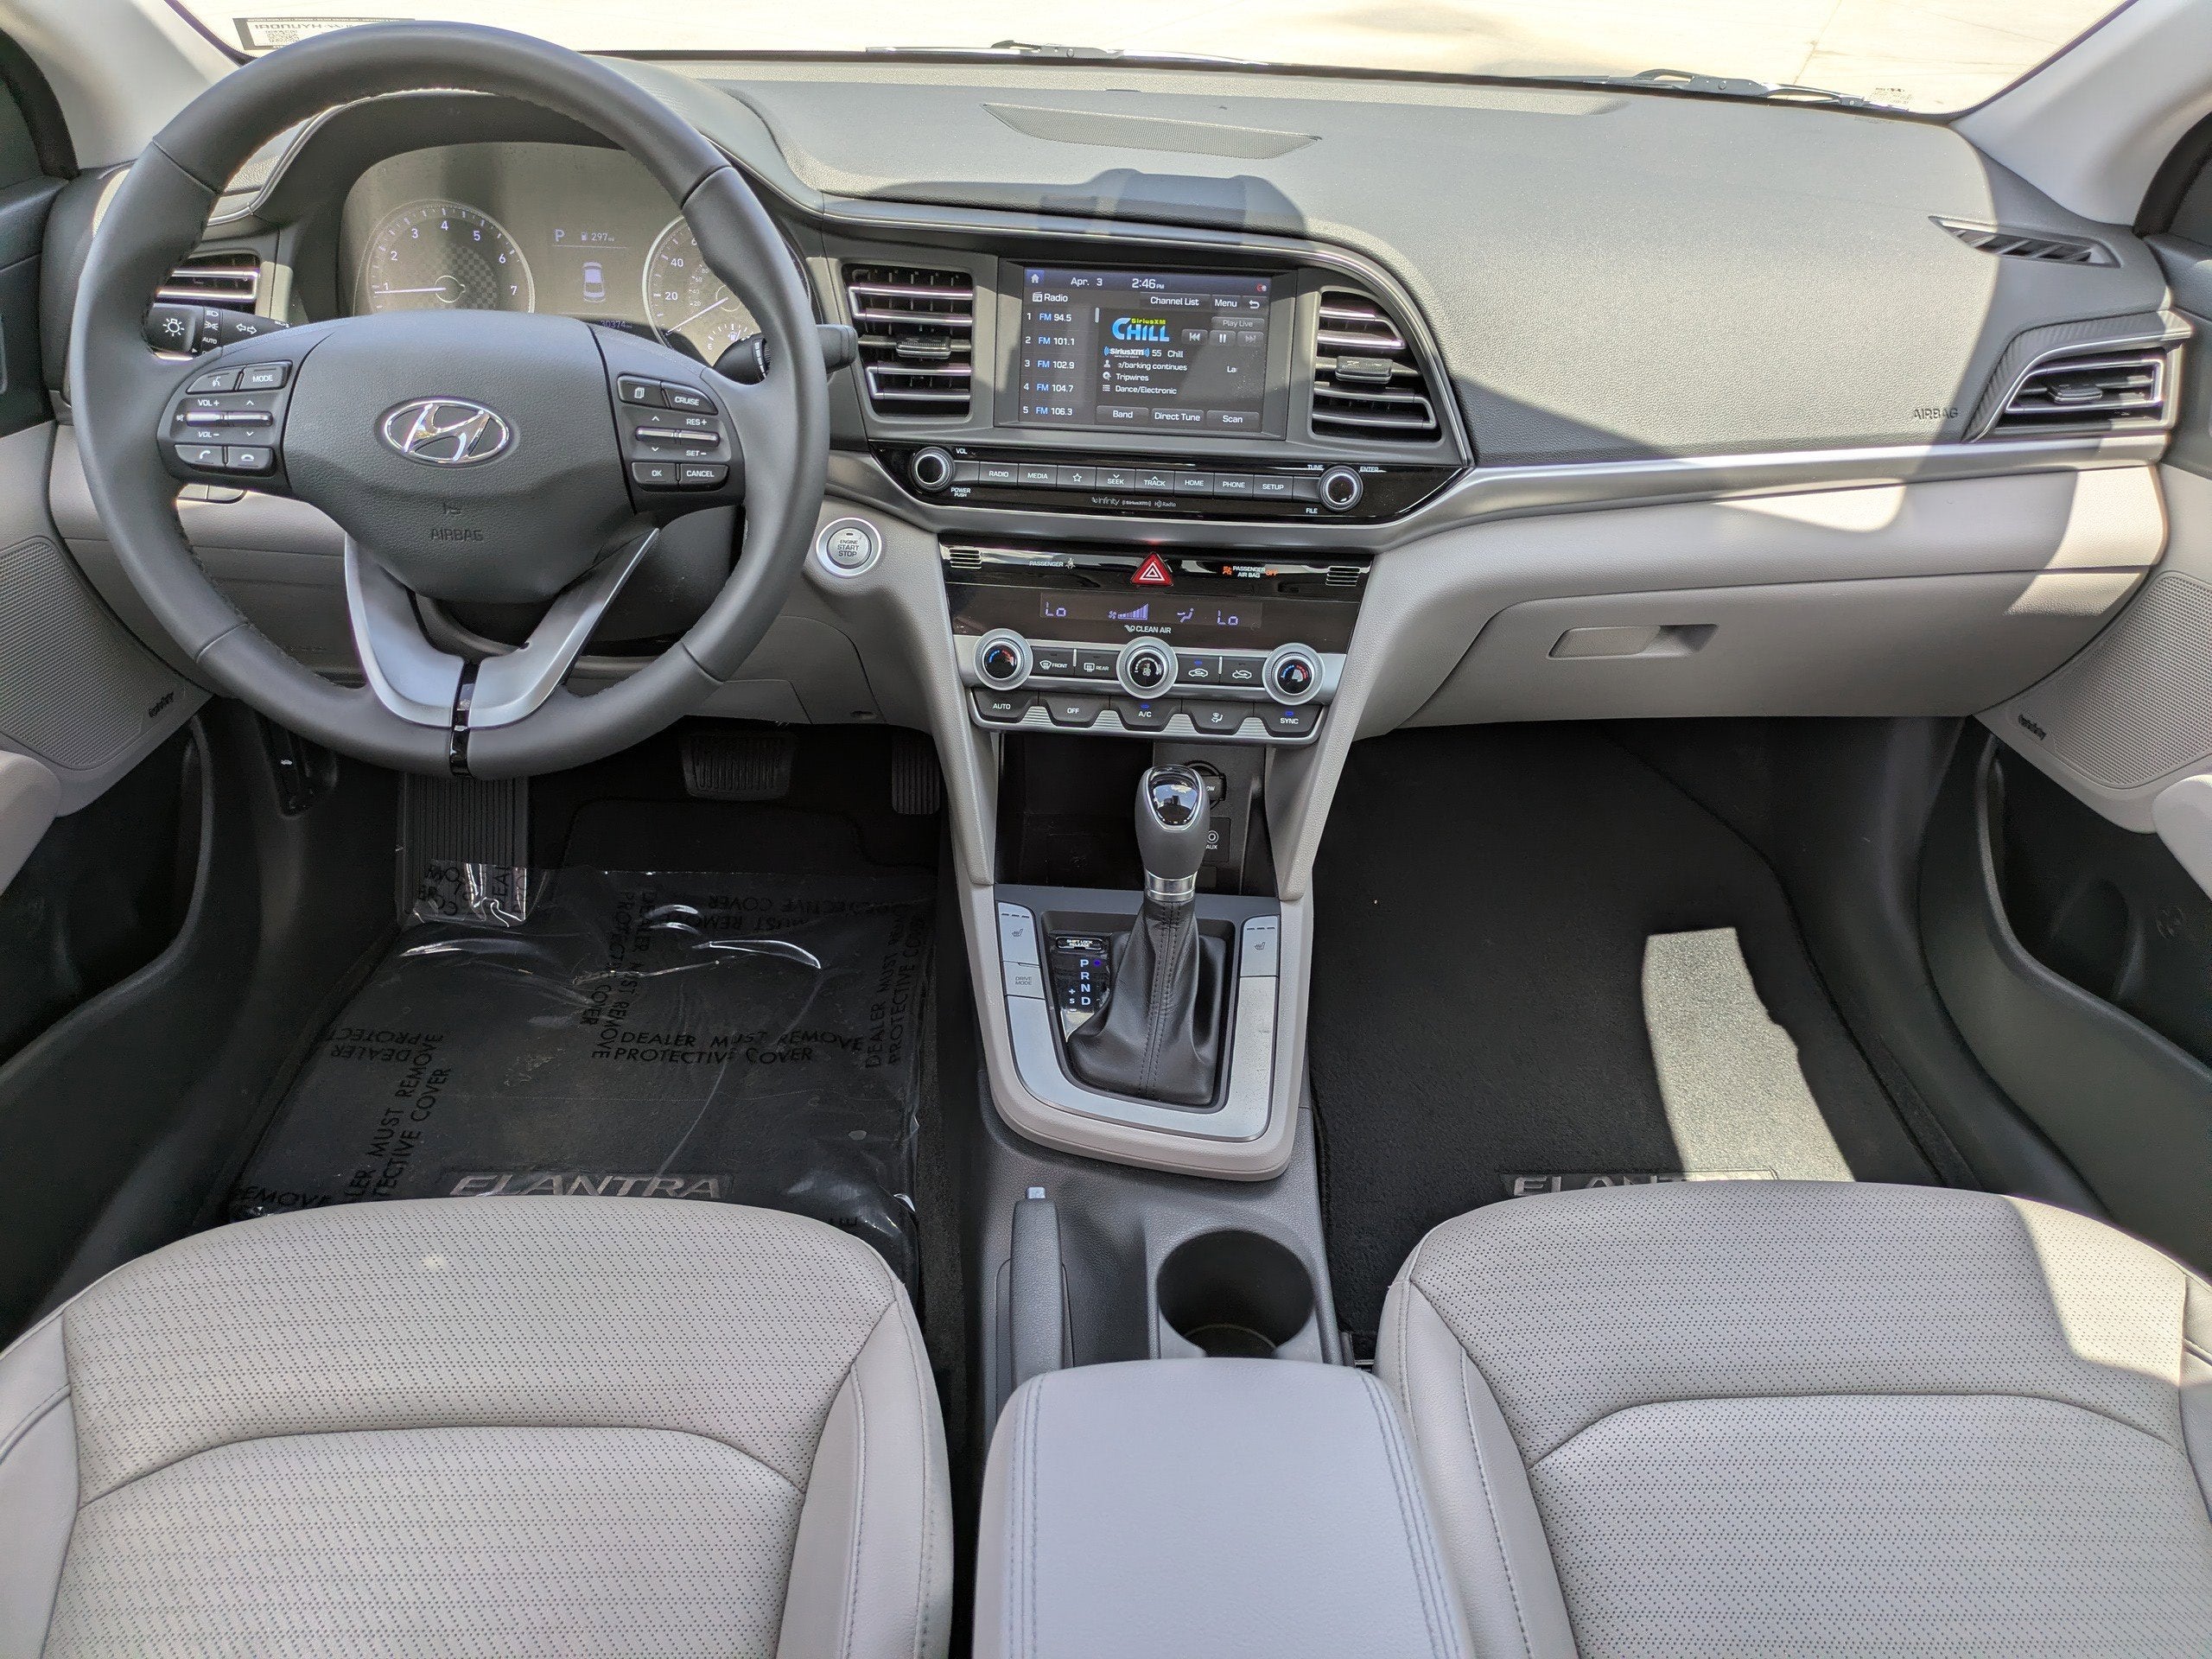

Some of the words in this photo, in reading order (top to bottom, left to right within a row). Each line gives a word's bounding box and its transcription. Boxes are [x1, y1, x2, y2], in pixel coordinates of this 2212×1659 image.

[441, 220, 448, 231] 4
[411, 228, 418, 238] 3
[474, 231, 480, 241] 5
[391, 251, 397, 261] 2
[499, 254, 506, 264] 6
[671, 258, 684, 268] 40
[1071, 276, 1090, 287] Apr.
[511, 285, 518, 296] 7
[1044, 294, 1068, 302] Radio
[1150, 296, 1182, 305] Channel
[1184, 297, 1199, 306] List
[1215, 299, 1237, 308] Menu
[1223, 319, 1237, 328] Play
[202, 336, 217, 345] AUTO
[1053, 337, 1075, 346] 101.1
[1052, 360, 1074, 369] 102.9
[1116, 372, 1148, 382] Tripwires
[1116, 385, 1177, 395] Dance/Electronic
[675, 396, 699, 405] CRUISE
[1051, 407, 1072, 416] 106.3
[1113, 410, 1133, 419] Band
[1913, 407, 1958, 420] AIRBAG
[1154, 412, 1179, 421] Direct
[1180, 413, 1200, 422] Tune
[432, 529, 483, 542] AIRBAG
[620, 1032, 696, 1047] DEALER
[746, 1047, 813, 1065] COVER
[449, 1174, 721, 1198] ELANTRA
